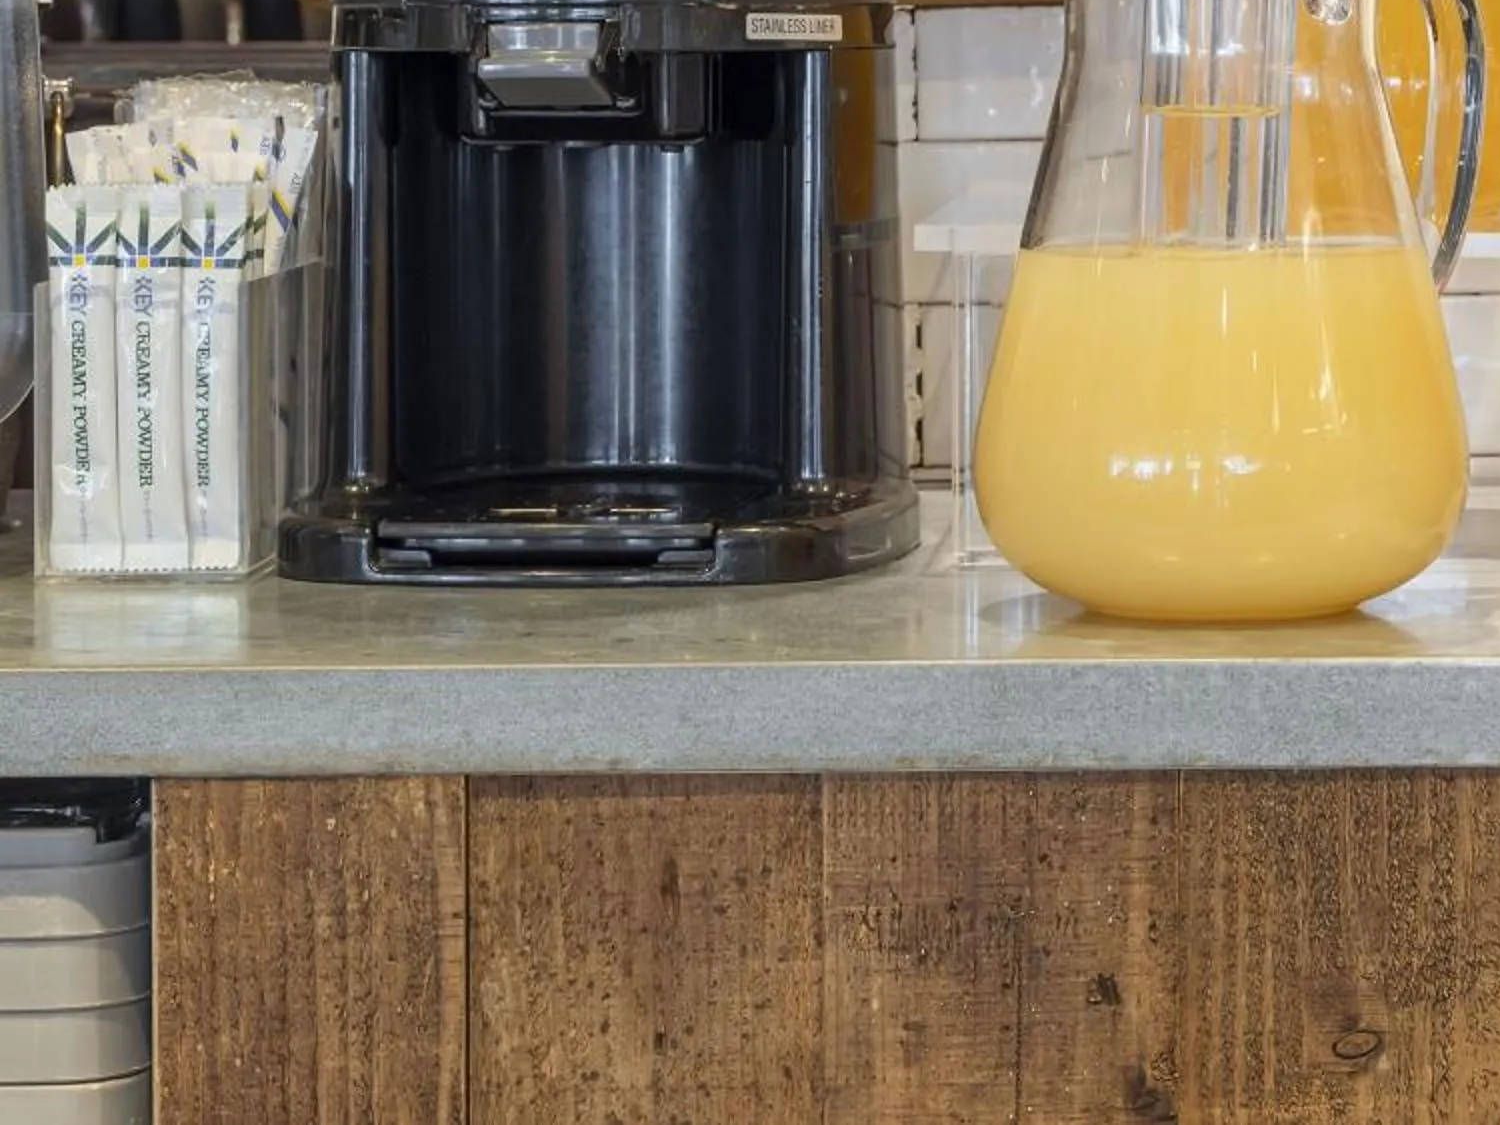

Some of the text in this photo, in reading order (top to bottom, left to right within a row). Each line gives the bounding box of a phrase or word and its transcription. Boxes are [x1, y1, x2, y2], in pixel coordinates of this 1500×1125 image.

[751, 17, 807, 34] STAINLESS
[69, 274, 88, 316] KEY
[134, 275, 153, 317] KEY
[71, 320, 87, 398] CREAMY
[135, 321, 151, 399] CREAMY
[73, 405, 90, 486] POWDER
[137, 407, 153, 488] POWDER
[196, 406, 211, 487] POWDER
